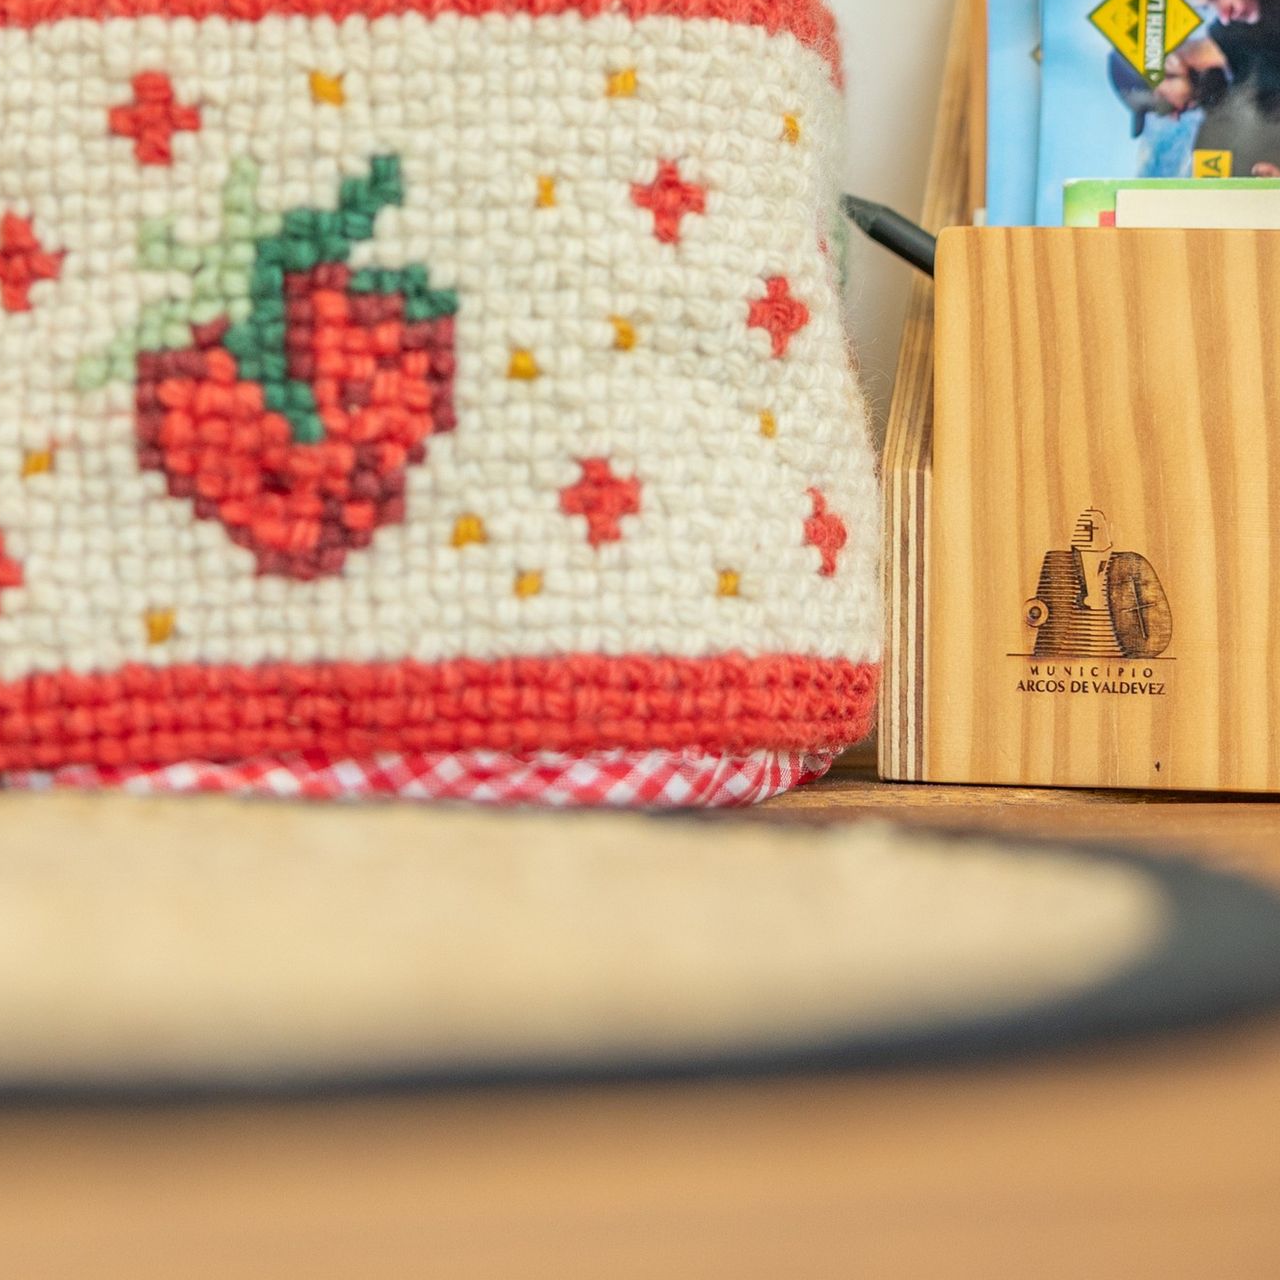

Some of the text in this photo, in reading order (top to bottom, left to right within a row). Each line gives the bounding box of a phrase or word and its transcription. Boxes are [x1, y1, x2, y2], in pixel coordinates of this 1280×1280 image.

[1016, 679, 1167, 696] ARCOS DE VALDEVEZ
